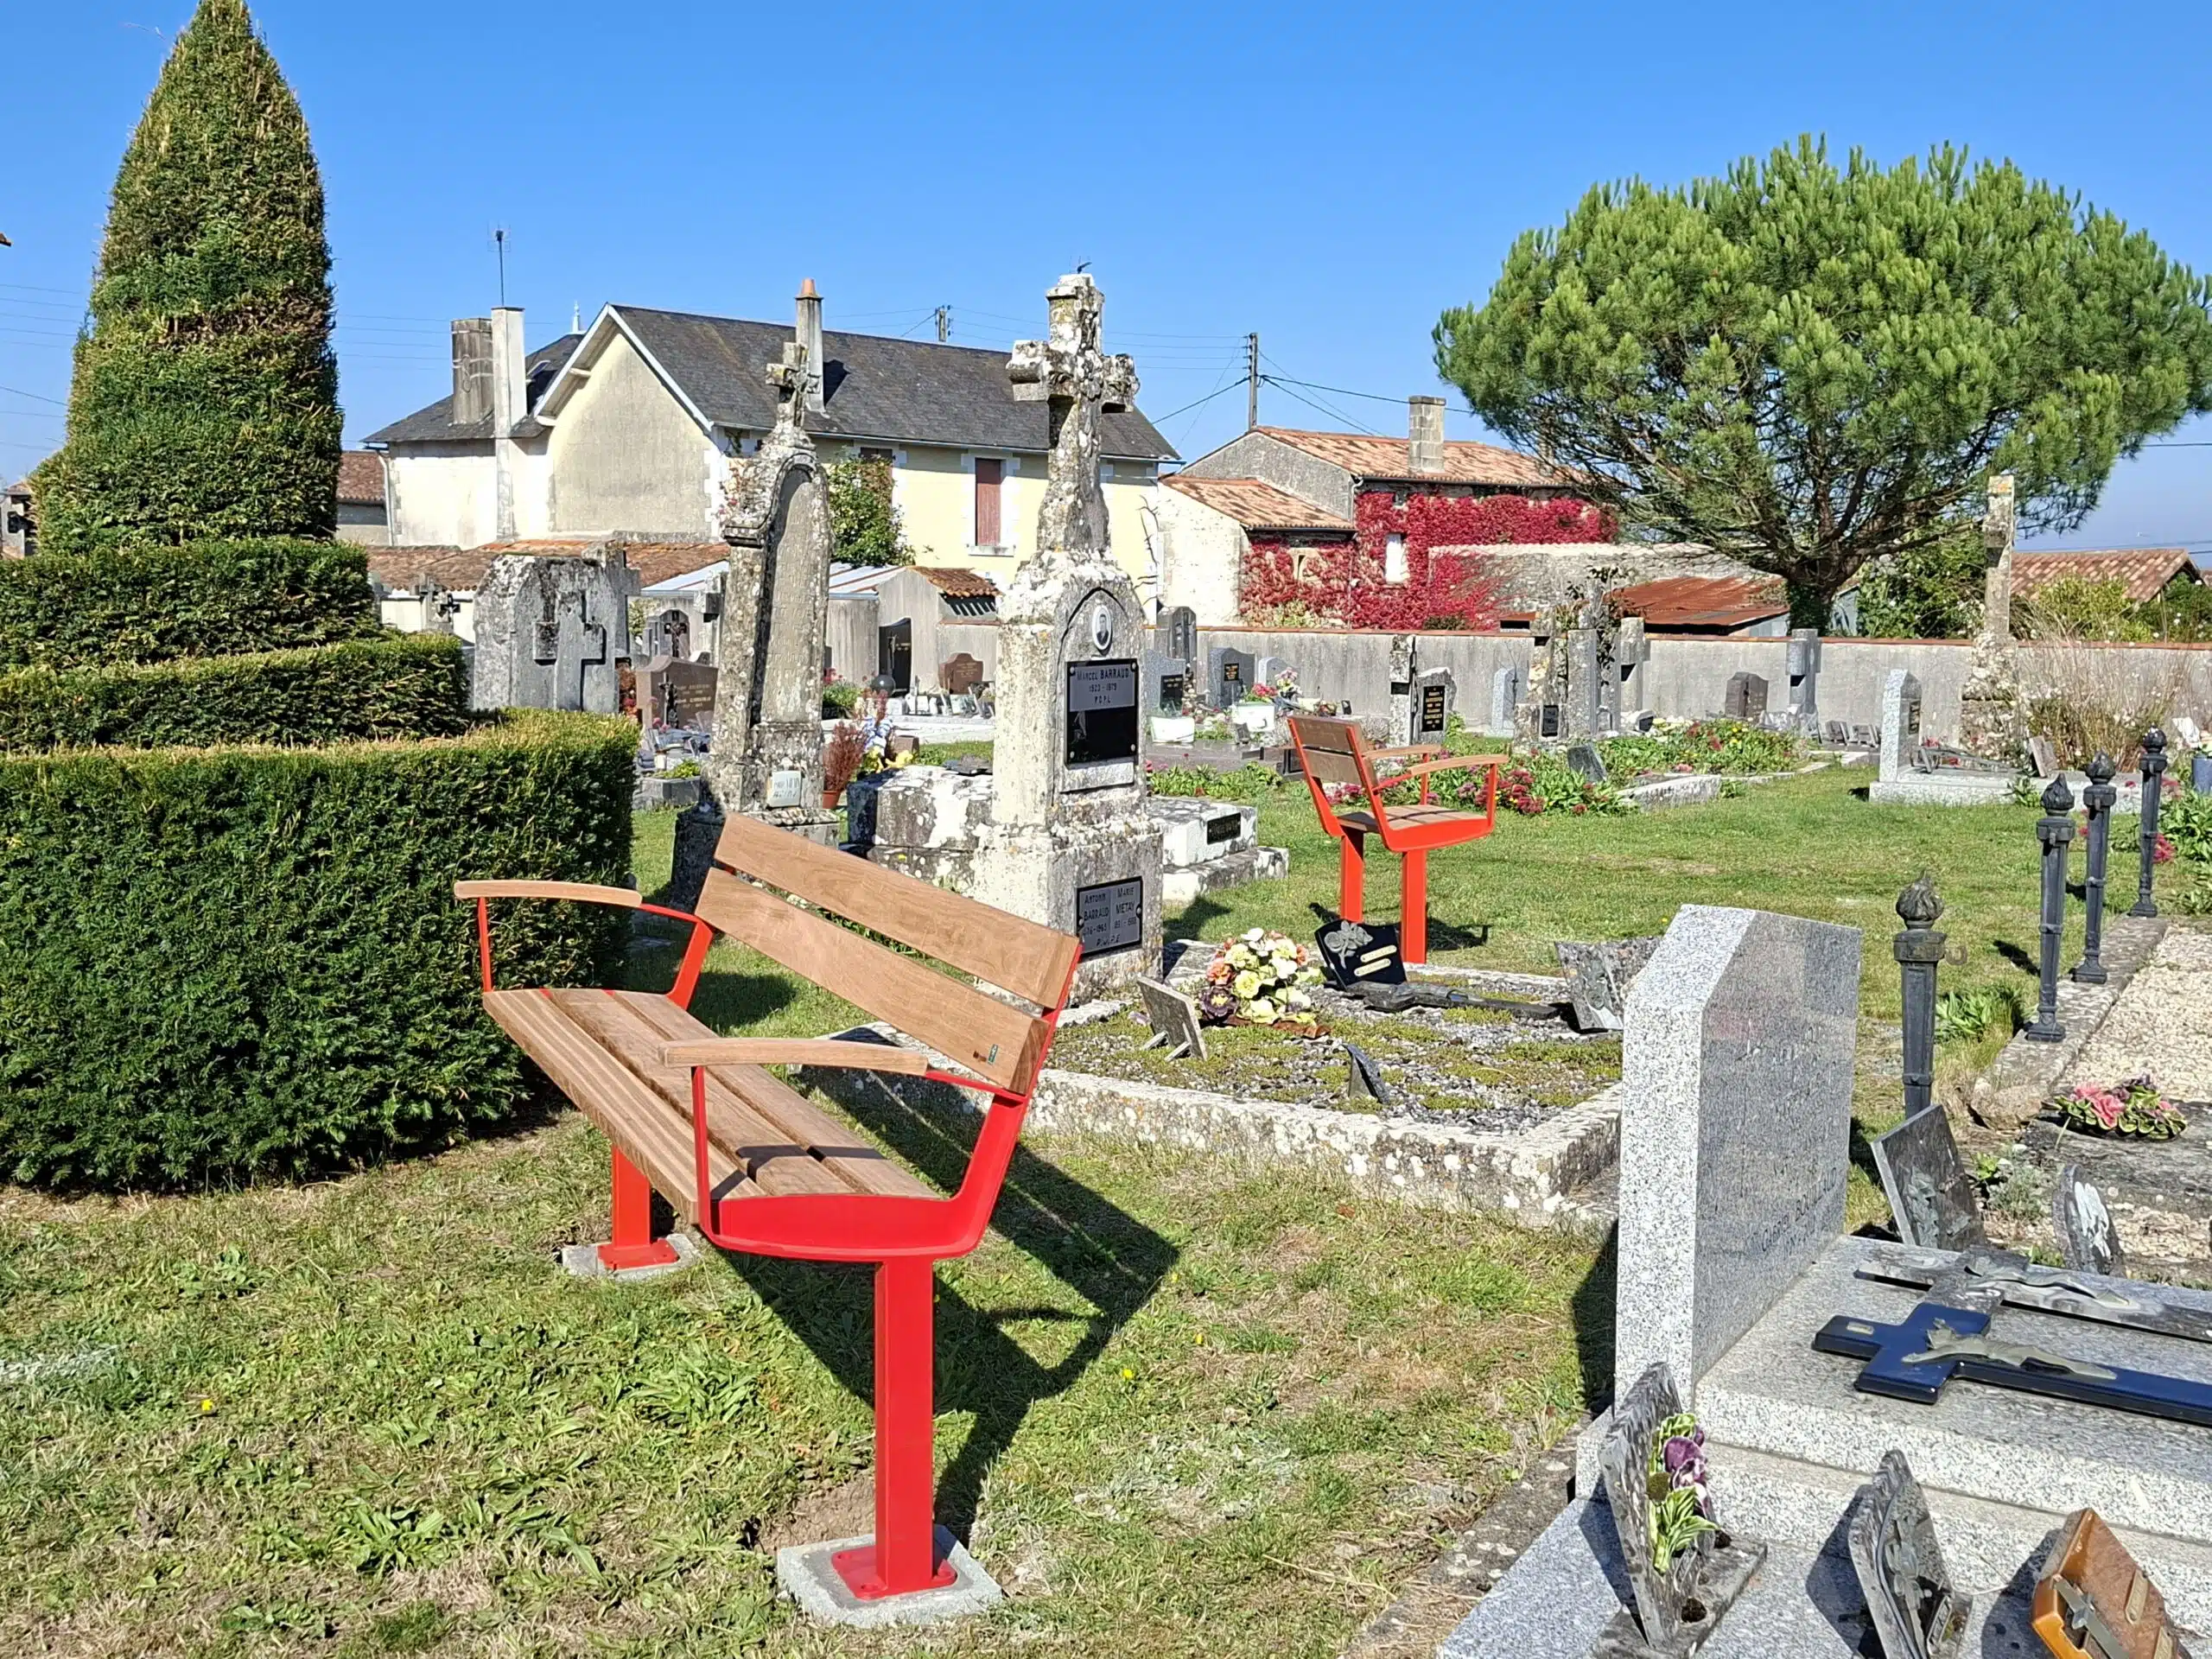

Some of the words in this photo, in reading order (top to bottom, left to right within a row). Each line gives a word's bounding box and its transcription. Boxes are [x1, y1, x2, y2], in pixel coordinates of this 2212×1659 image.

[1100, 668, 1129, 680] BARRAUD
[1117, 887, 1135, 898] MARIE
[1084, 906, 1109, 921] BARRAUD
